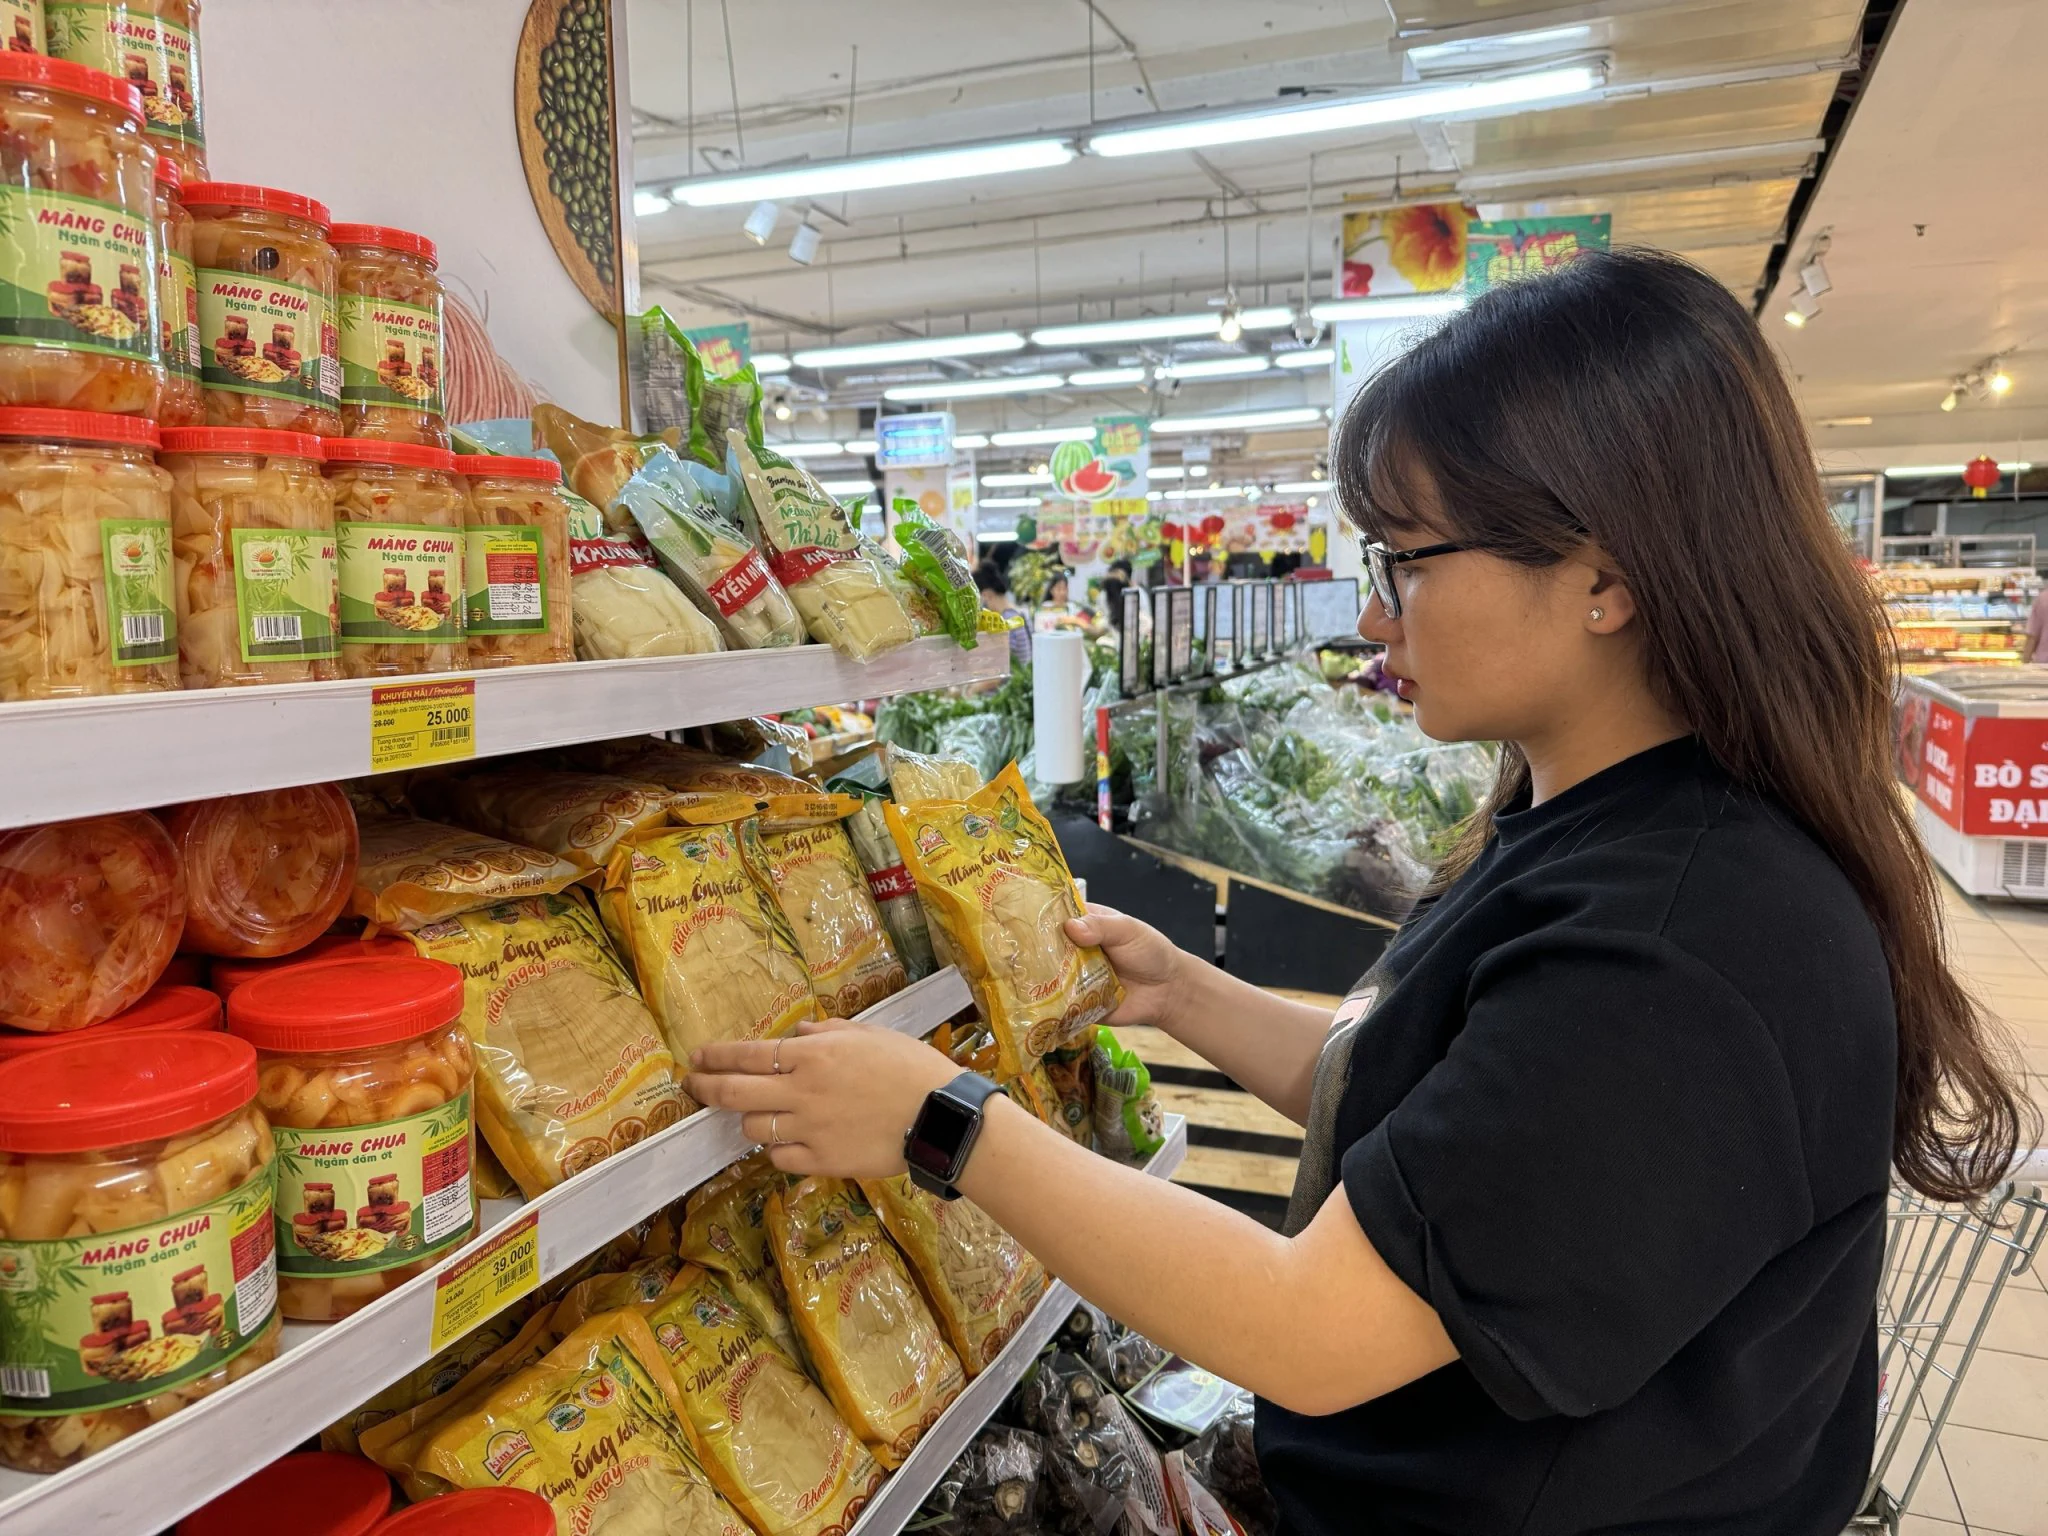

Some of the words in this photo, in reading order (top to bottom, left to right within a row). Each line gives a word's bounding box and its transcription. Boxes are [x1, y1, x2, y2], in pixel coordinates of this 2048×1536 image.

[106, 20, 156, 40] MĂNG
[38, 207, 105, 233] MĂNG
[58, 230, 100, 248] Ngâm
[212, 282, 263, 301] MĂNG
[270, 292, 309, 313] CHUA
[225, 298, 257, 312] Ngâm
[372, 310, 414, 326] MĂNG
[368, 535, 417, 551] MĂNG
[423, 539, 454, 553] CHUA
[382, 552, 414, 563] Ngâm
[381, 689, 412, 701] KHUYẾN
[434, 685, 468, 696] Promotion
[427, 708, 467, 726] 25.000
[1974, 758, 2022, 788] BÒ
[937, 864, 984, 887] Măng
[636, 895, 689, 915] Măng
[689, 874, 725, 906] Ống
[723, 879, 744, 896] khô
[671, 922, 692, 957] nấu
[691, 904, 725, 929] ngay
[501, 934, 546, 963] Ống
[546, 931, 572, 952] khô
[486, 988, 509, 1025] nấu
[507, 961, 547, 988] ngay
[555, 1084, 607, 1119] Hương
[621, 1042, 646, 1067] Tây
[300, 1139, 353, 1157] MĂNG
[360, 1133, 406, 1153] CHUA
[314, 1157, 349, 1169] Ngâm
[352, 1154, 377, 1165] dấm
[381, 1151, 393, 1161] ớt
[82, 1238, 150, 1266] MĂNG
[159, 1215, 211, 1248] CHUA
[102, 1258, 146, 1276] Ngâm
[453, 1252, 482, 1278] KHUYẾN
[493, 1241, 531, 1277] 39.000
[851, 1260, 875, 1289] ngay
[685, 1367, 728, 1395] Măng
[719, 1335, 753, 1368] Ống
[732, 1361, 760, 1390] ngay
[489, 1451, 511, 1470] kim
[509, 1434, 528, 1450] bôi
[571, 1434, 620, 1481] Ống
[570, 1504, 593, 1536] ấu
[585, 1464, 625, 1504] ngay
[624, 1455, 650, 1473] 500g
[797, 1474, 835, 1513] Hương
